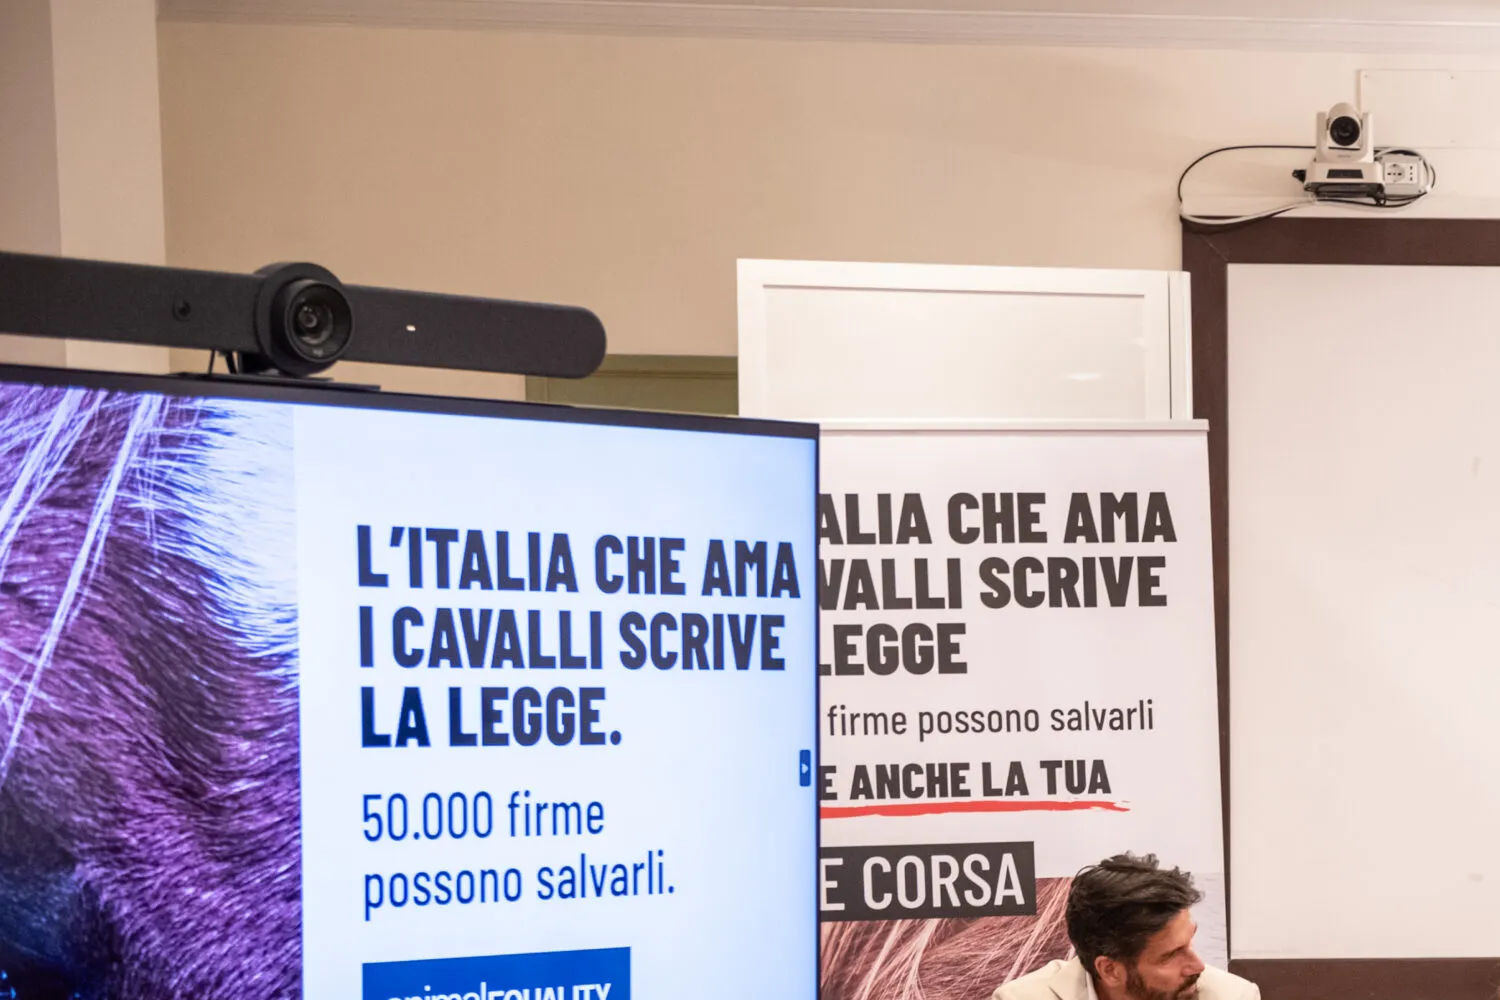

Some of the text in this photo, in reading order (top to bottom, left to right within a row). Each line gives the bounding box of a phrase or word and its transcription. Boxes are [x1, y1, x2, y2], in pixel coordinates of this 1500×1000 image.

[947, 492, 1048, 545] CHE
[1063, 492, 1178, 544] AMA
[356, 525, 801, 599] L'ITALIA CHE AMA
[979, 556, 1168, 609] SCRIVE
[359, 606, 786, 671] I CAVALLI SCRIVE
[360, 685, 623, 748] LA LEGGE.
[827, 699, 1154, 742] firme possono salvarli
[849, 763, 971, 800] ANCHE
[981, 760, 1029, 797] LA
[1039, 760, 1112, 796] TUA
[362, 790, 604, 842] 50.000 firme
[364, 850, 675, 921] possono salvarli.
[862, 853, 1025, 909] CORSA
